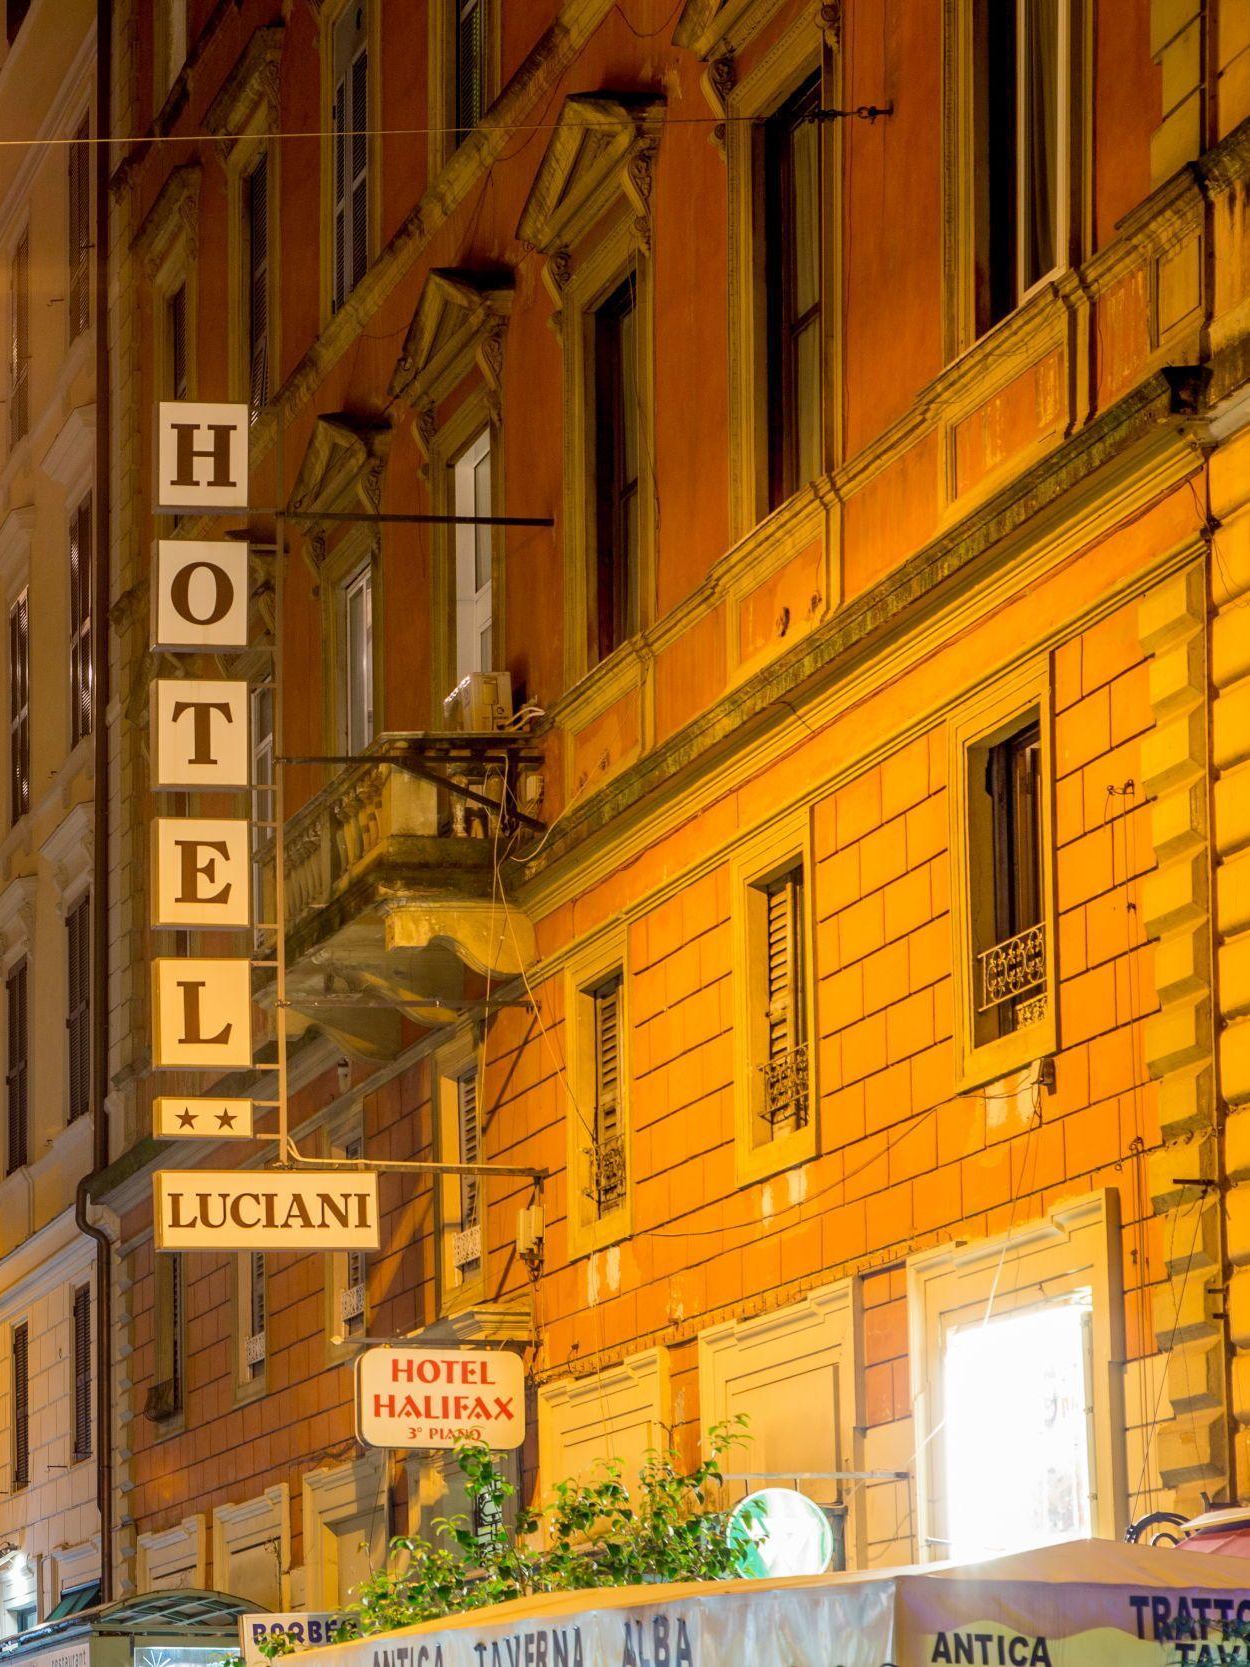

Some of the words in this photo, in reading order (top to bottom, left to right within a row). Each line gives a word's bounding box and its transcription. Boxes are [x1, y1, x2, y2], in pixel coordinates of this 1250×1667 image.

[170, 423, 237, 1044] HOTEL
[167, 1192, 372, 1229] LUCIANI
[391, 1358, 496, 1385] HOTEL
[373, 1394, 515, 1421] HALIFAX
[429, 1427, 482, 1441] PIANO
[473, 1624, 584, 1667] TAVERNA
[622, 1614, 693, 1667] ALBA
[931, 1631, 1052, 1667] ANTICA
[1174, 1642, 1250, 1667] TAV
